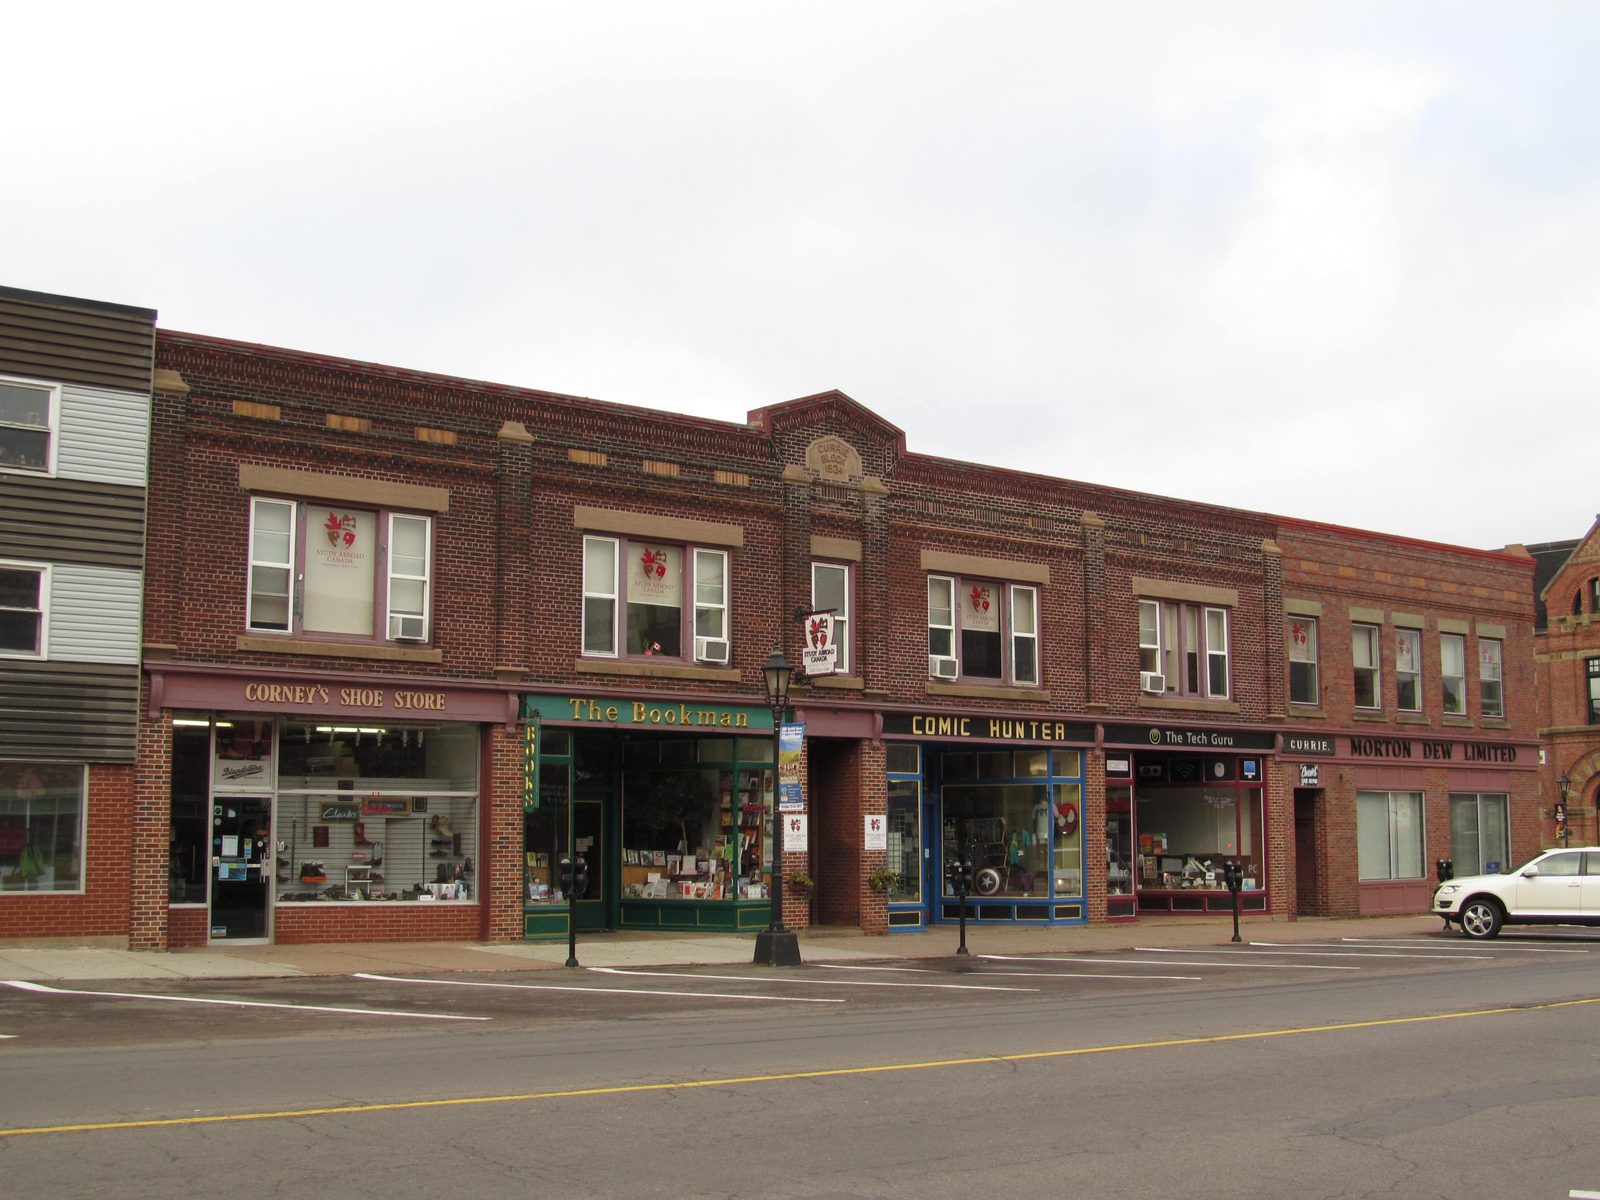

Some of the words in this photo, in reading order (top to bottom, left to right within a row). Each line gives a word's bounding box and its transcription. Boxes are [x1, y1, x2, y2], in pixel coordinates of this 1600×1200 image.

[817, 443, 850, 457] CURRIE
[820, 453, 848, 466] BLOCK
[316, 549, 337, 557] STUDY
[338, 551, 365, 560] ABROAD
[326, 556, 353, 564] CANADA
[245, 683, 329, 704] CORNEY'S
[340, 688, 384, 707] SHOE
[394, 691, 446, 710] STORE
[569, 698, 619, 721] The
[631, 701, 749, 728] Bookman
[912, 715, 971, 737] COMIC
[989, 719, 1065, 741] HUNTER
[1165, 731, 1183, 744] The
[1186, 732, 1207, 745] Tech
[1211, 733, 1233, 746] Guru
[1350, 737, 1412, 759] MORTON
[1422, 741, 1454, 760] DEW
[1464, 743, 1517, 763] LIMITED
[525, 726, 536, 808] BOOKS
[322, 807, 357, 819] Clarks
[1247, 864, 1258, 873] PC
